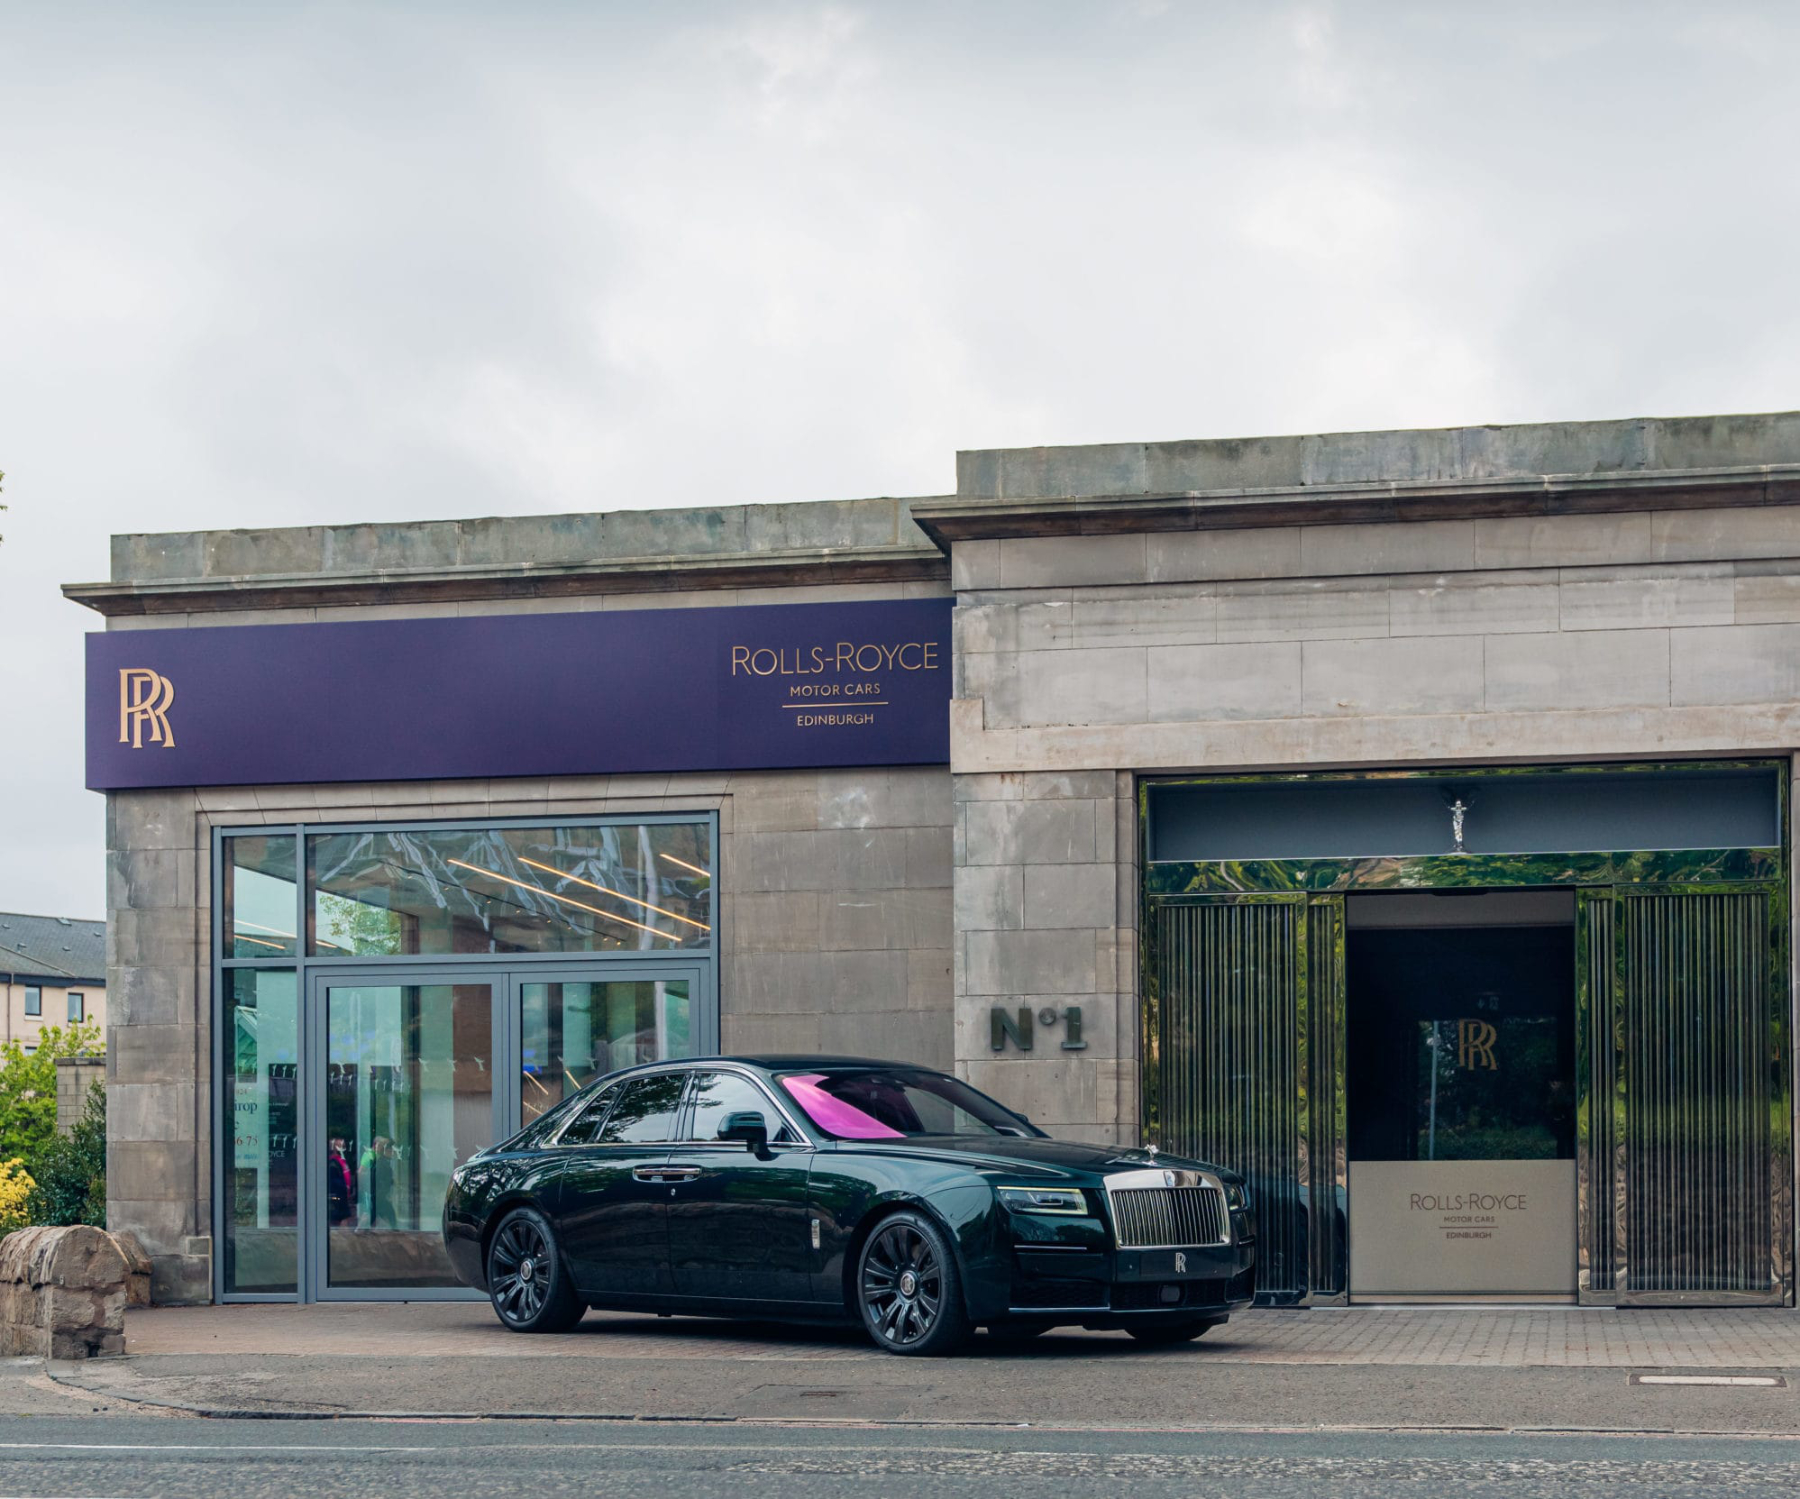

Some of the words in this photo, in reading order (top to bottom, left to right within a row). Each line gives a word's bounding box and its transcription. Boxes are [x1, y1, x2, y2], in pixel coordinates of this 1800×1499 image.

[732, 642, 939, 676] ROLLS-ROYCE
[790, 685, 840, 697] MOTOR
[844, 683, 881, 695] CARS
[797, 713, 874, 727] EDINBURGH
[1410, 1193, 1527, 1211] ROLLS-ROYCE
[1443, 1215, 1473, 1223] MOTOR
[1474, 1215, 1496, 1223] CARS
[1446, 1231, 1492, 1240] EDINBURGH
